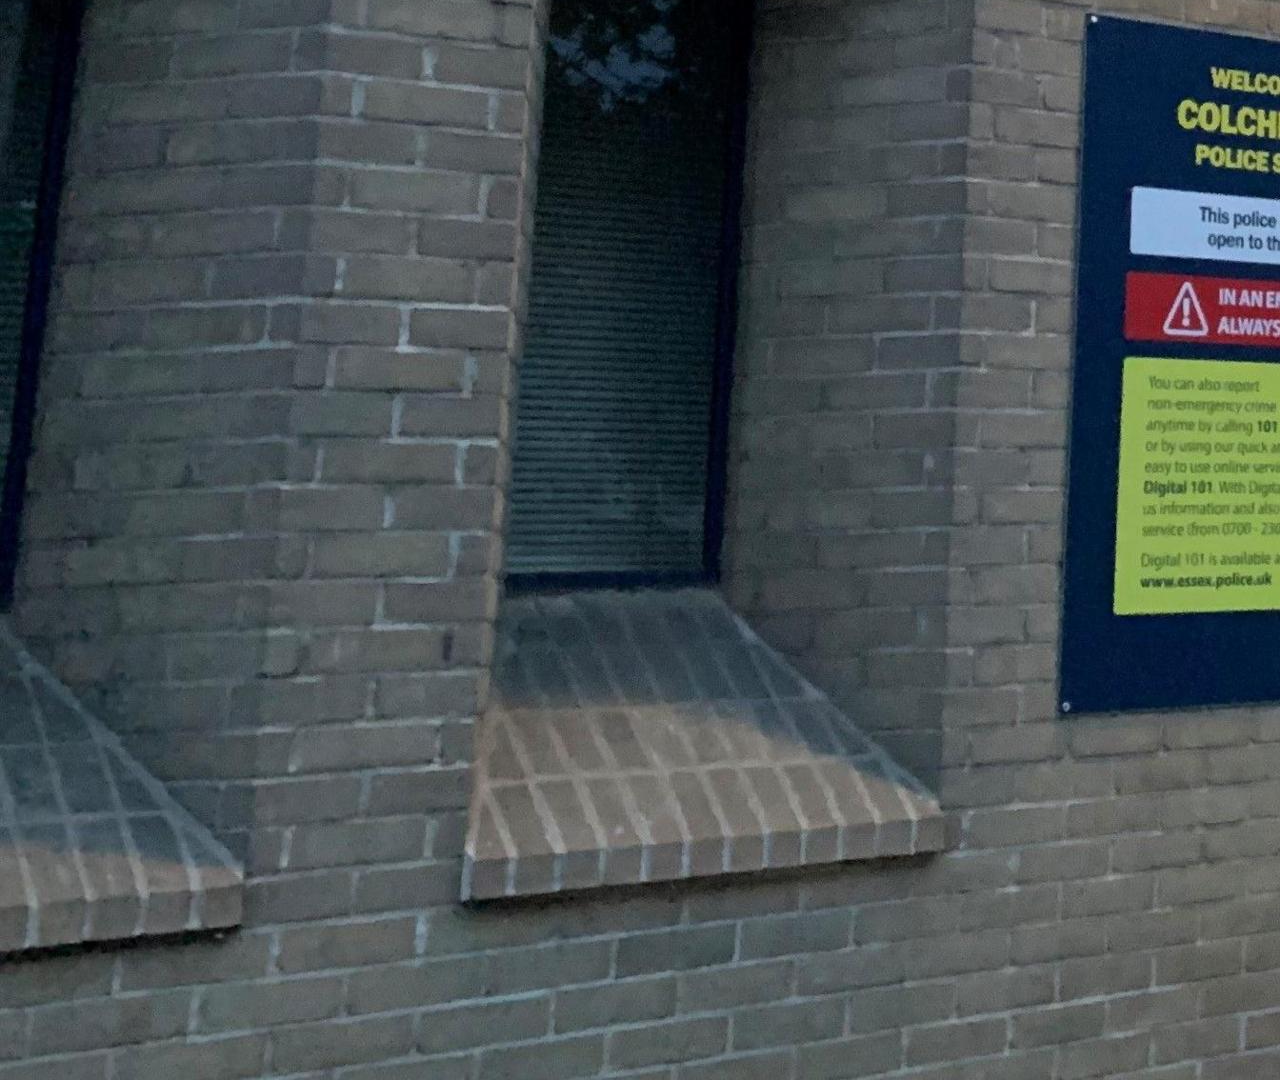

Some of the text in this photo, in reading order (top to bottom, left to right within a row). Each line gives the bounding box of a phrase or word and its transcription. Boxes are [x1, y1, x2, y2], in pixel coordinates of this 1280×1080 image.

[1195, 143, 1269, 172] POLICE
[1199, 206, 1229, 224] This
[1233, 211, 1276, 228] police
[1208, 233, 1244, 249] open
[1248, 234, 1263, 250] to
[1219, 288, 1236, 306] IN
[1239, 289, 1263, 307] AN
[1217, 316, 1280, 337] ALWAYS
[1257, 420, 1278, 433] 101
[1144, 480, 1187, 497] Digital
[1140, 572, 1272, 591] www.essex.police.uk
